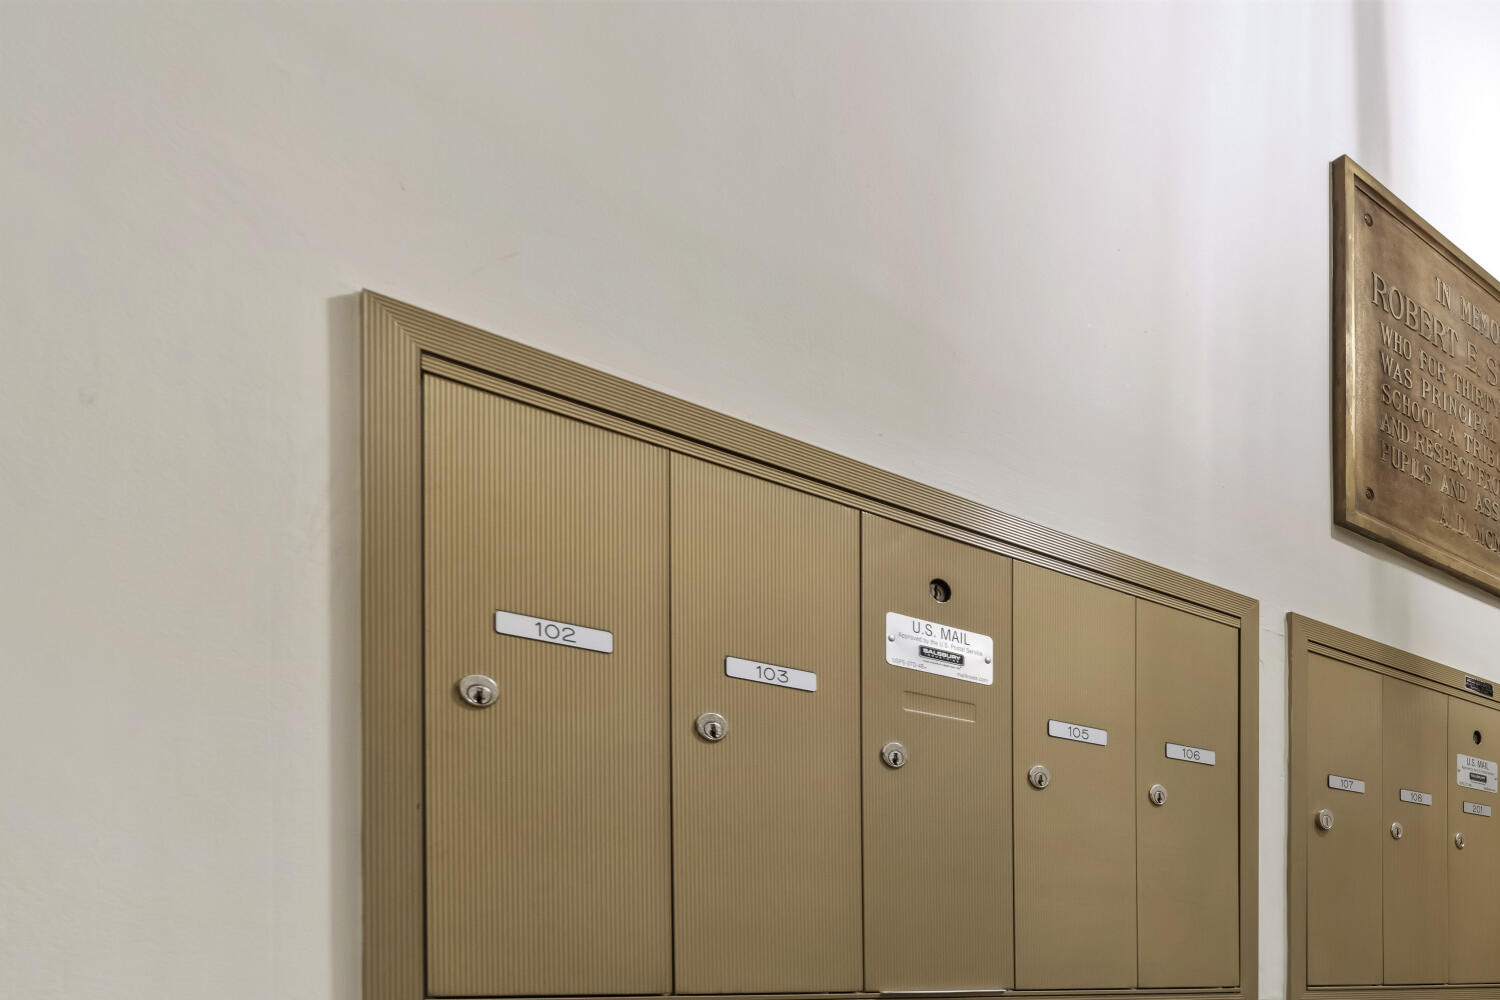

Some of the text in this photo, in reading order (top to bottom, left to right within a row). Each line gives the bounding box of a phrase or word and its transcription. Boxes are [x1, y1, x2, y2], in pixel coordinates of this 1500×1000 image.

[1435, 276, 1451, 310] IN
[1371, 271, 1459, 359] ROBERT
[1379, 320, 1412, 361] WHO
[1419, 350, 1447, 386] FOR
[1380, 351, 1413, 390] WAS
[1421, 378, 1497, 445] PRINCIPAL
[1382, 383, 1442, 438] SCHOOL.
[1448, 424, 1458, 448] A
[1379, 412, 1410, 445] AND
[1414, 430, 1475, 482] RESPECT
[1380, 440, 1433, 486] PUPILS
[1440, 475, 1467, 504] AND
[534, 621, 577, 644] 102
[912, 619, 971, 646] U.S. MAIL
[756, 665, 789, 683] 103
[1067, 725, 1090, 741] 105
[1181, 747, 1201, 762] 106
[1340, 779, 1355, 790] 107
[1410, 792, 1423, 803] 108
[1472, 804, 1484, 814] 201
